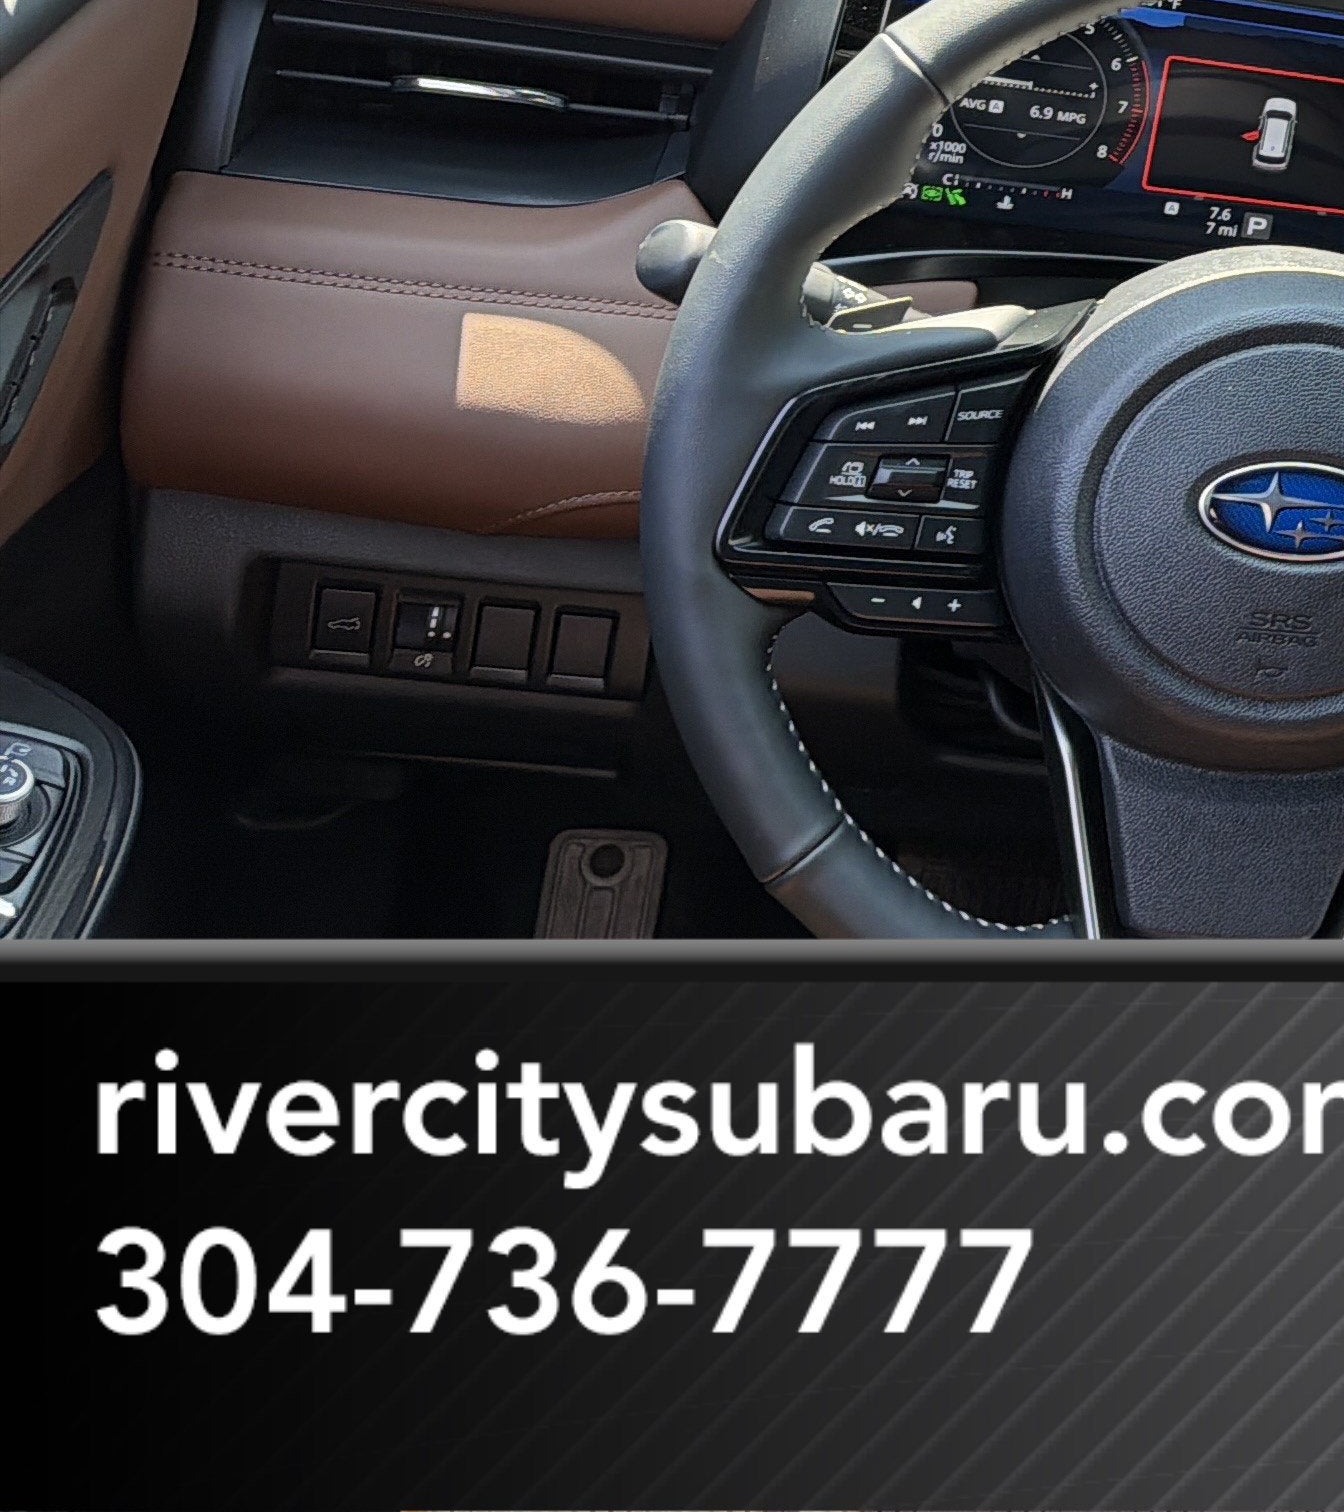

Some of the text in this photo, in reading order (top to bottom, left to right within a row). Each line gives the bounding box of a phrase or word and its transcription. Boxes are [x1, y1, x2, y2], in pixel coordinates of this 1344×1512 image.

[1110, 57, 1122, 71] 6
[959, 97, 987, 111] AVG
[1116, 101, 1129, 114] 7
[1029, 105, 1087, 125] 6.9 MPG
[931, 122, 943, 137] 0
[929, 140, 967, 155] x1000
[1096, 144, 1108, 159] 8
[926, 151, 965, 165] r/min
[942, 174, 952, 185] C
[1062, 188, 1074, 200] H
[1209, 206, 1231, 221] 7.6
[1205, 221, 1238, 238] 7 mi
[1246, 217, 1268, 235] P
[956, 408, 1004, 421] SOURCE
[953, 468, 975, 479] TRIP
[947, 477, 978, 489] RESET
[1250, 612, 1314, 632] SRS
